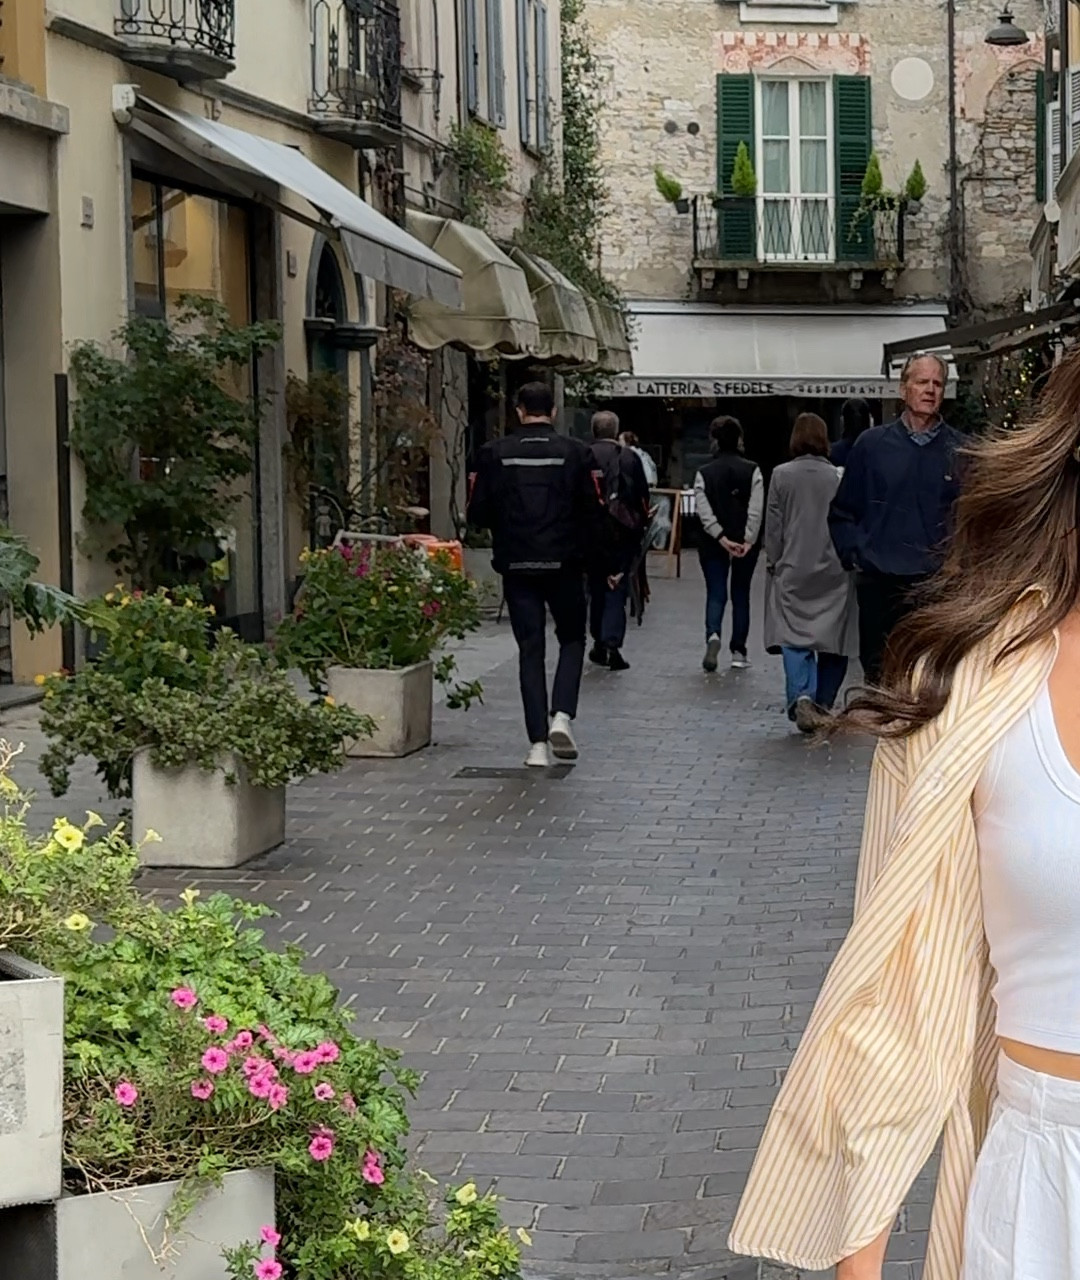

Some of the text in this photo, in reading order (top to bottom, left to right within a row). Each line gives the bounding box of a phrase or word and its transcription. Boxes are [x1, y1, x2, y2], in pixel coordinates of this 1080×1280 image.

[636, 381, 884, 395] LATTERIA S.FEDELE RESTAURANT
